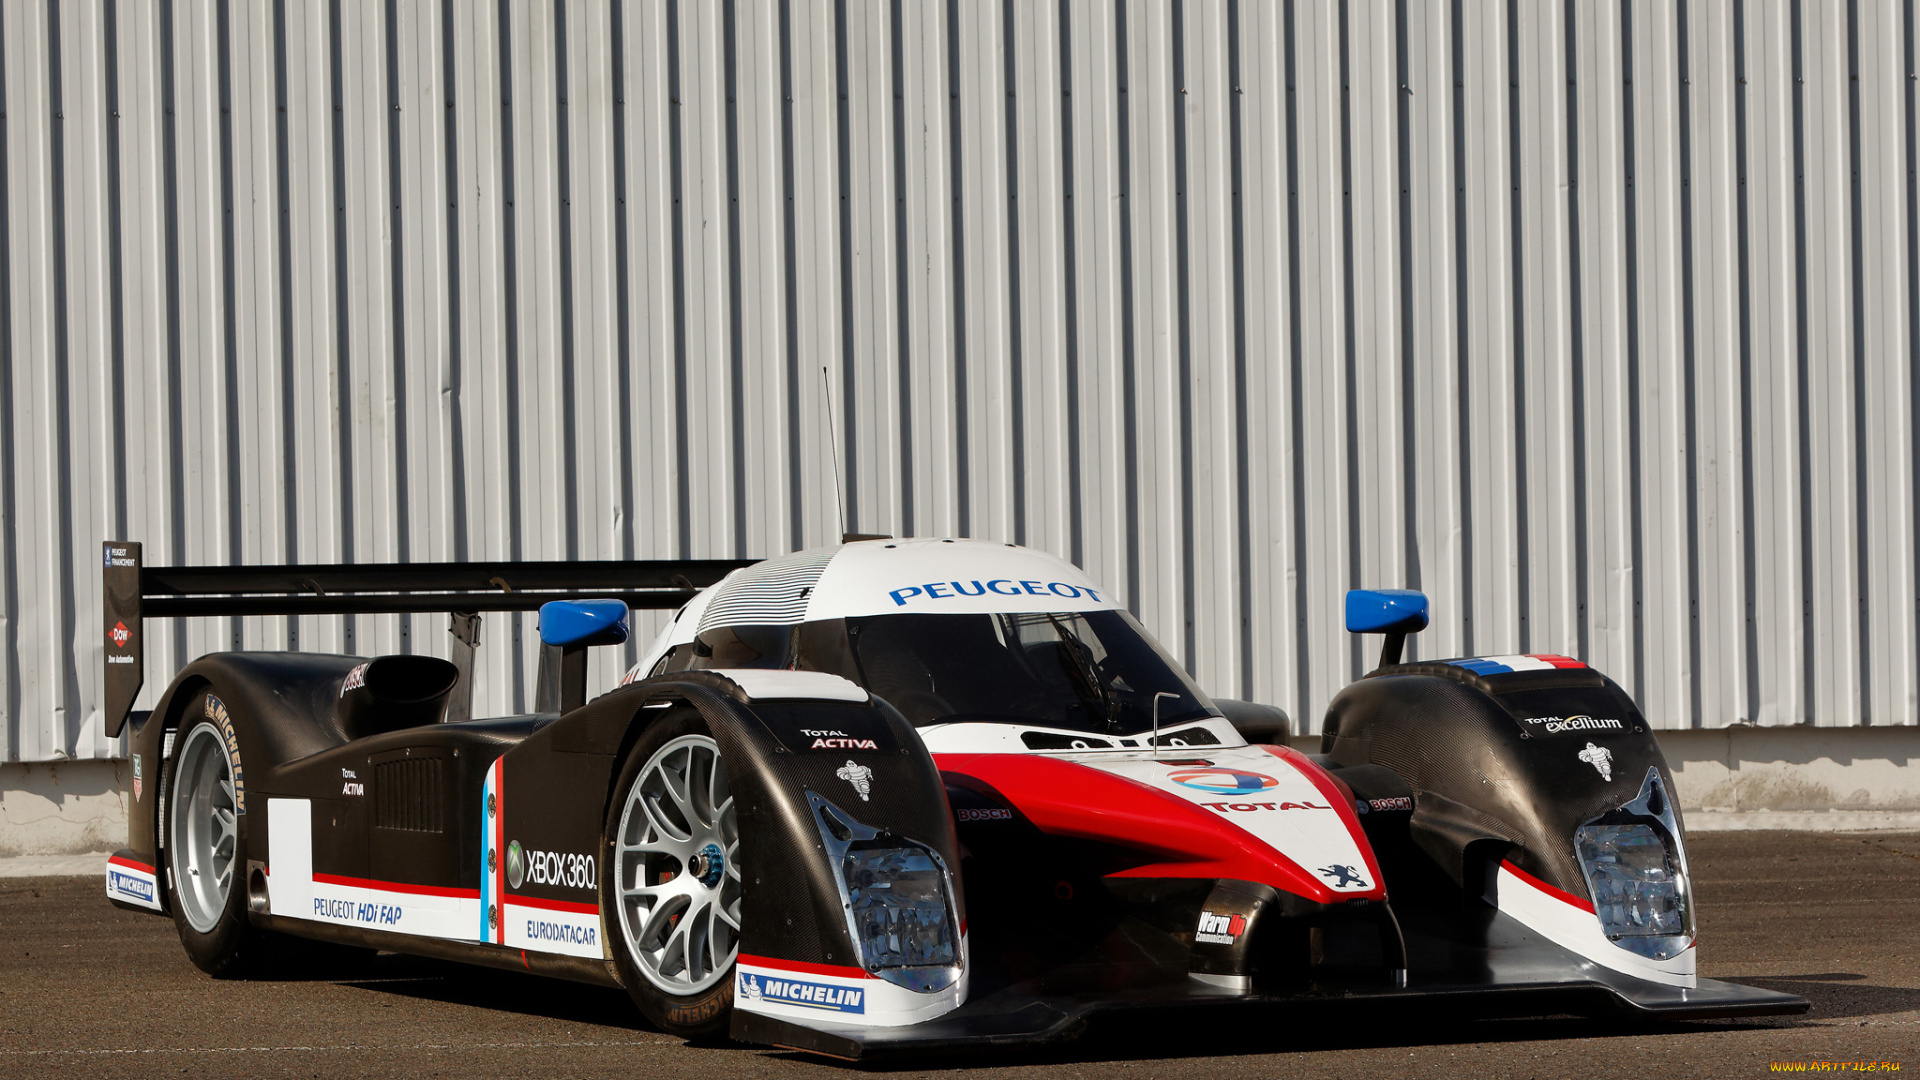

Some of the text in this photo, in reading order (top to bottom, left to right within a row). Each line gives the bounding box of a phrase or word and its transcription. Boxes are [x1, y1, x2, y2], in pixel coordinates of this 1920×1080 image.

[112, 548, 127, 556] PEUGEOT
[889, 579, 1102, 607] PEUGEOT
[1525, 716, 1563, 724] TOTAL
[1545, 716, 1623, 732] excellium
[800, 729, 848, 737] TOTAL
[811, 738, 879, 750] ACTIVA
[215, 704, 245, 810] MICHELIN
[342, 768, 356, 778] TOTAL
[342, 782, 364, 796] ACTIVA
[1200, 801, 1332, 813] TOTAL
[1371, 797, 1412, 811] BOSCH
[958, 809, 1012, 821] BOSCH
[119, 875, 152, 896] MICHELIN
[314, 898, 402, 925] PEUGEOT HDi FAP
[527, 920, 596, 945] EURODATACAR
[765, 980, 862, 1007] MICHELIN
